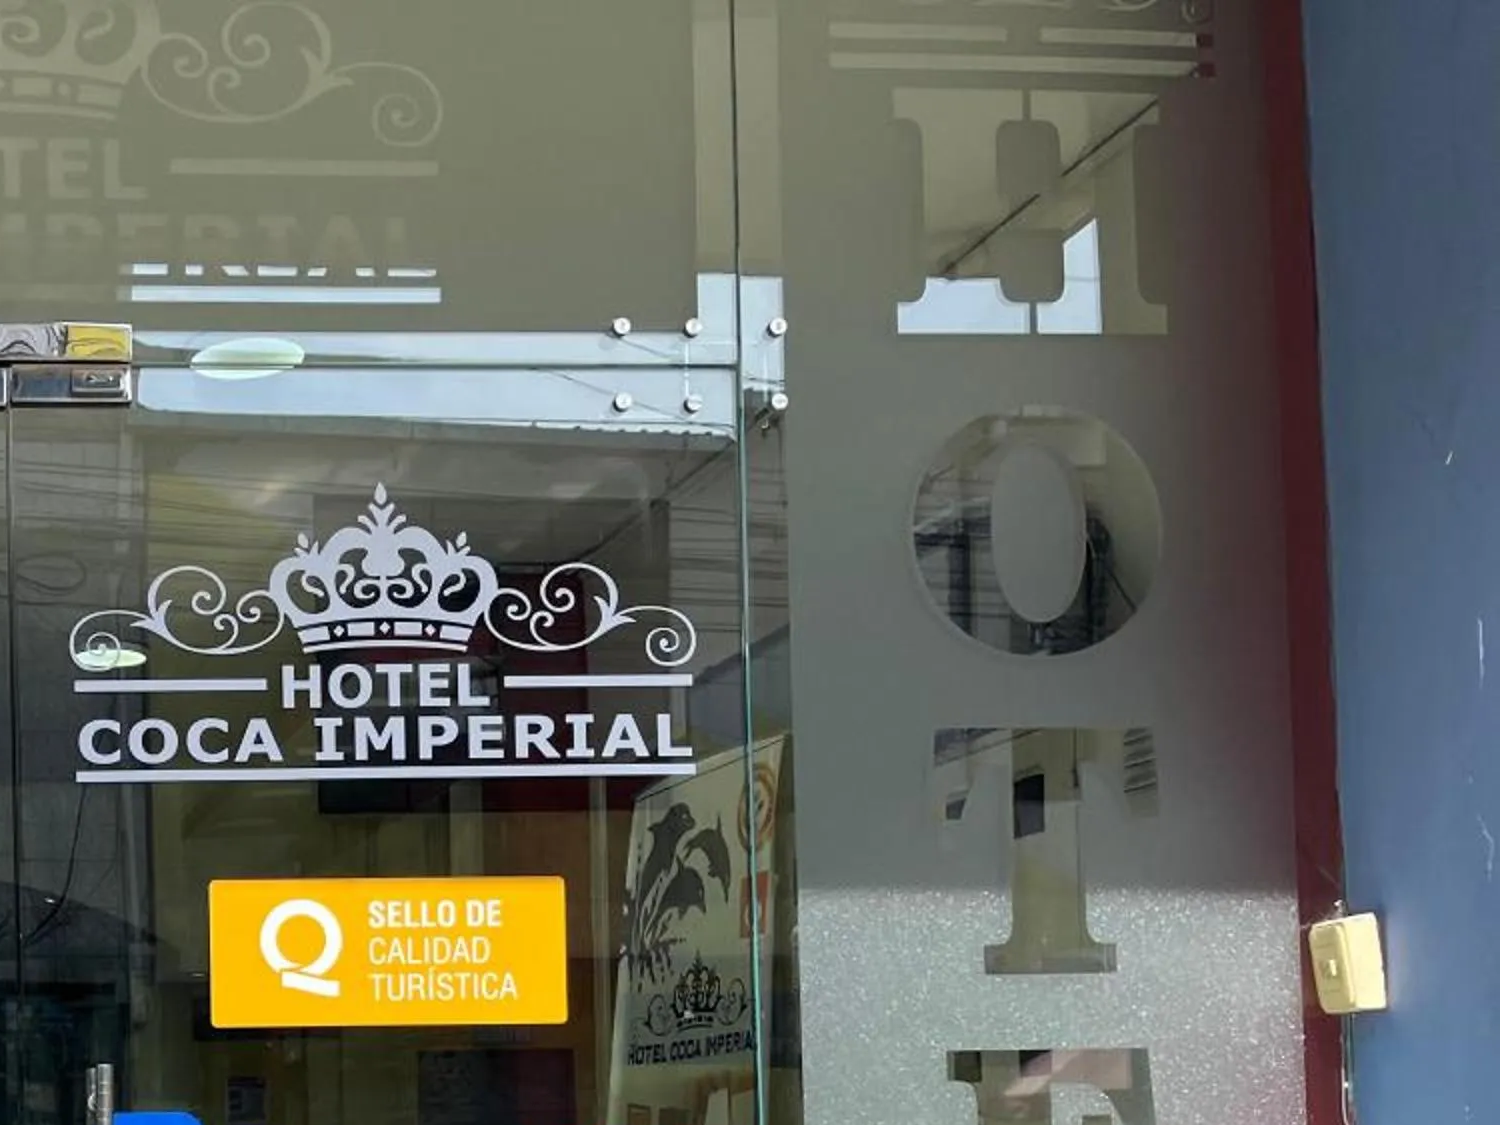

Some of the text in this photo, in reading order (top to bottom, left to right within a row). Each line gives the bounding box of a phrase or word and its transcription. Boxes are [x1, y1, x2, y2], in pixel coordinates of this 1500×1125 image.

[282, 663, 490, 709] HOTEL
[79, 713, 693, 764] COCA IMPERIAL
[368, 899, 503, 928] SELLO DE
[369, 936, 490, 965] CALIDAD
[371, 966, 518, 1001] TURÍSTICA
[706, 1030, 755, 1057] IMPERIA
